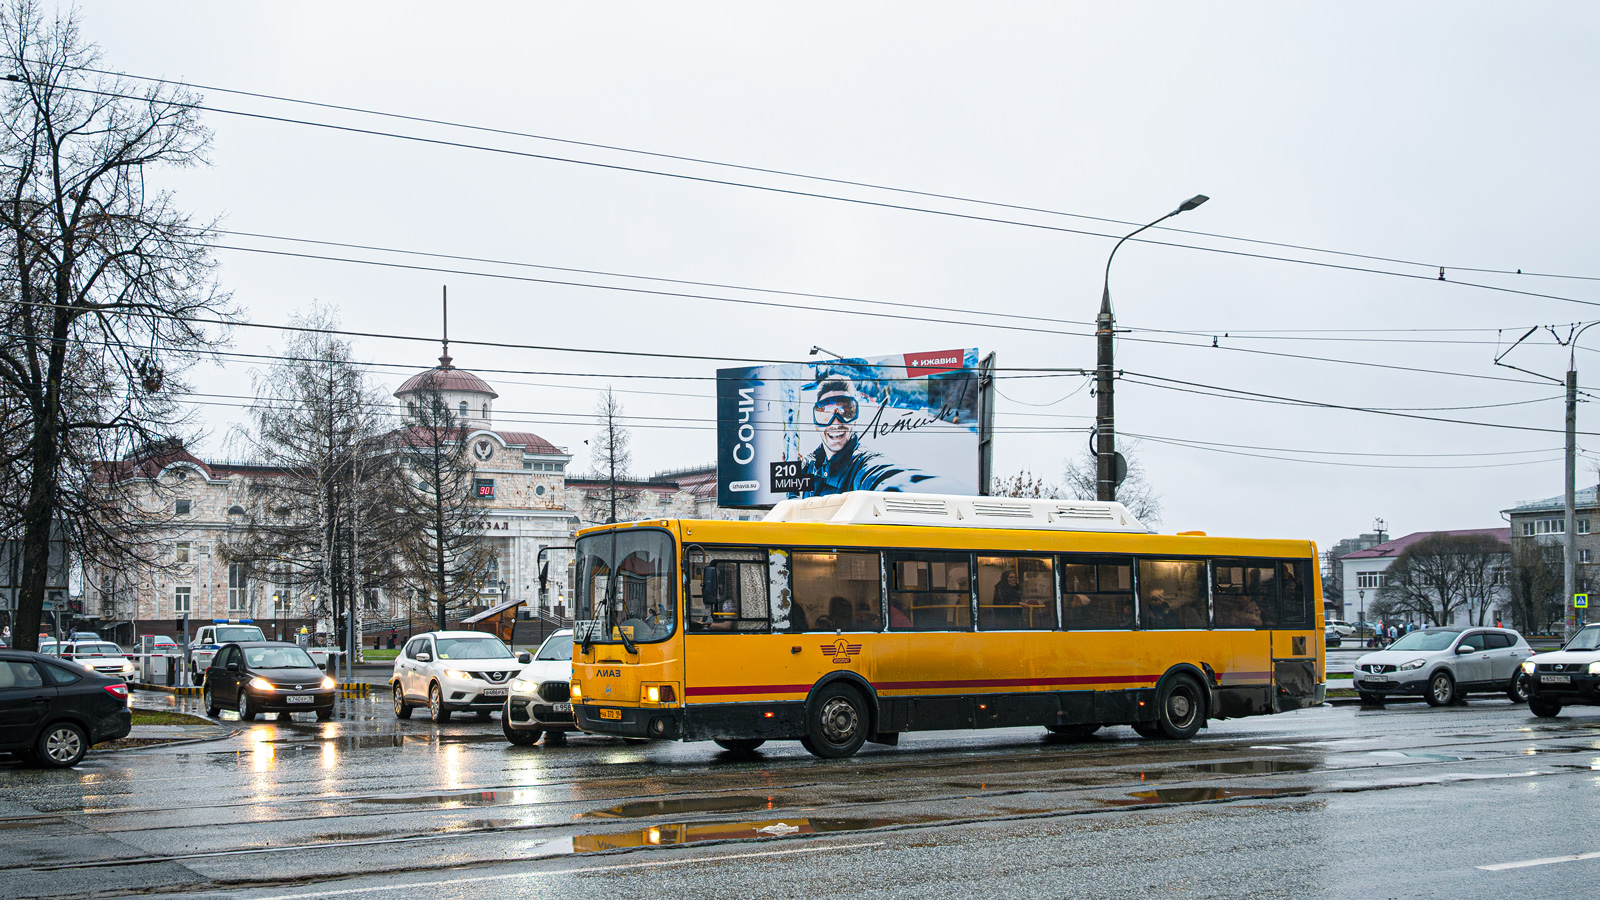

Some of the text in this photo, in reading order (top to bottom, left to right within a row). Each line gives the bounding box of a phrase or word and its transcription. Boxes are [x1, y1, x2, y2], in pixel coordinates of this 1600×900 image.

[920, 357, 958, 366] ижавиа
[733, 388, 755, 465] Сочи
[775, 465, 797, 477] 210
[732, 482, 757, 490] izhavia.su
[775, 477, 811, 490] минут
[461, 521, 509, 530] ВОКЗАЛ
[575, 621, 585, 640] 25
[596, 669, 621, 677] ЛИАЗ
